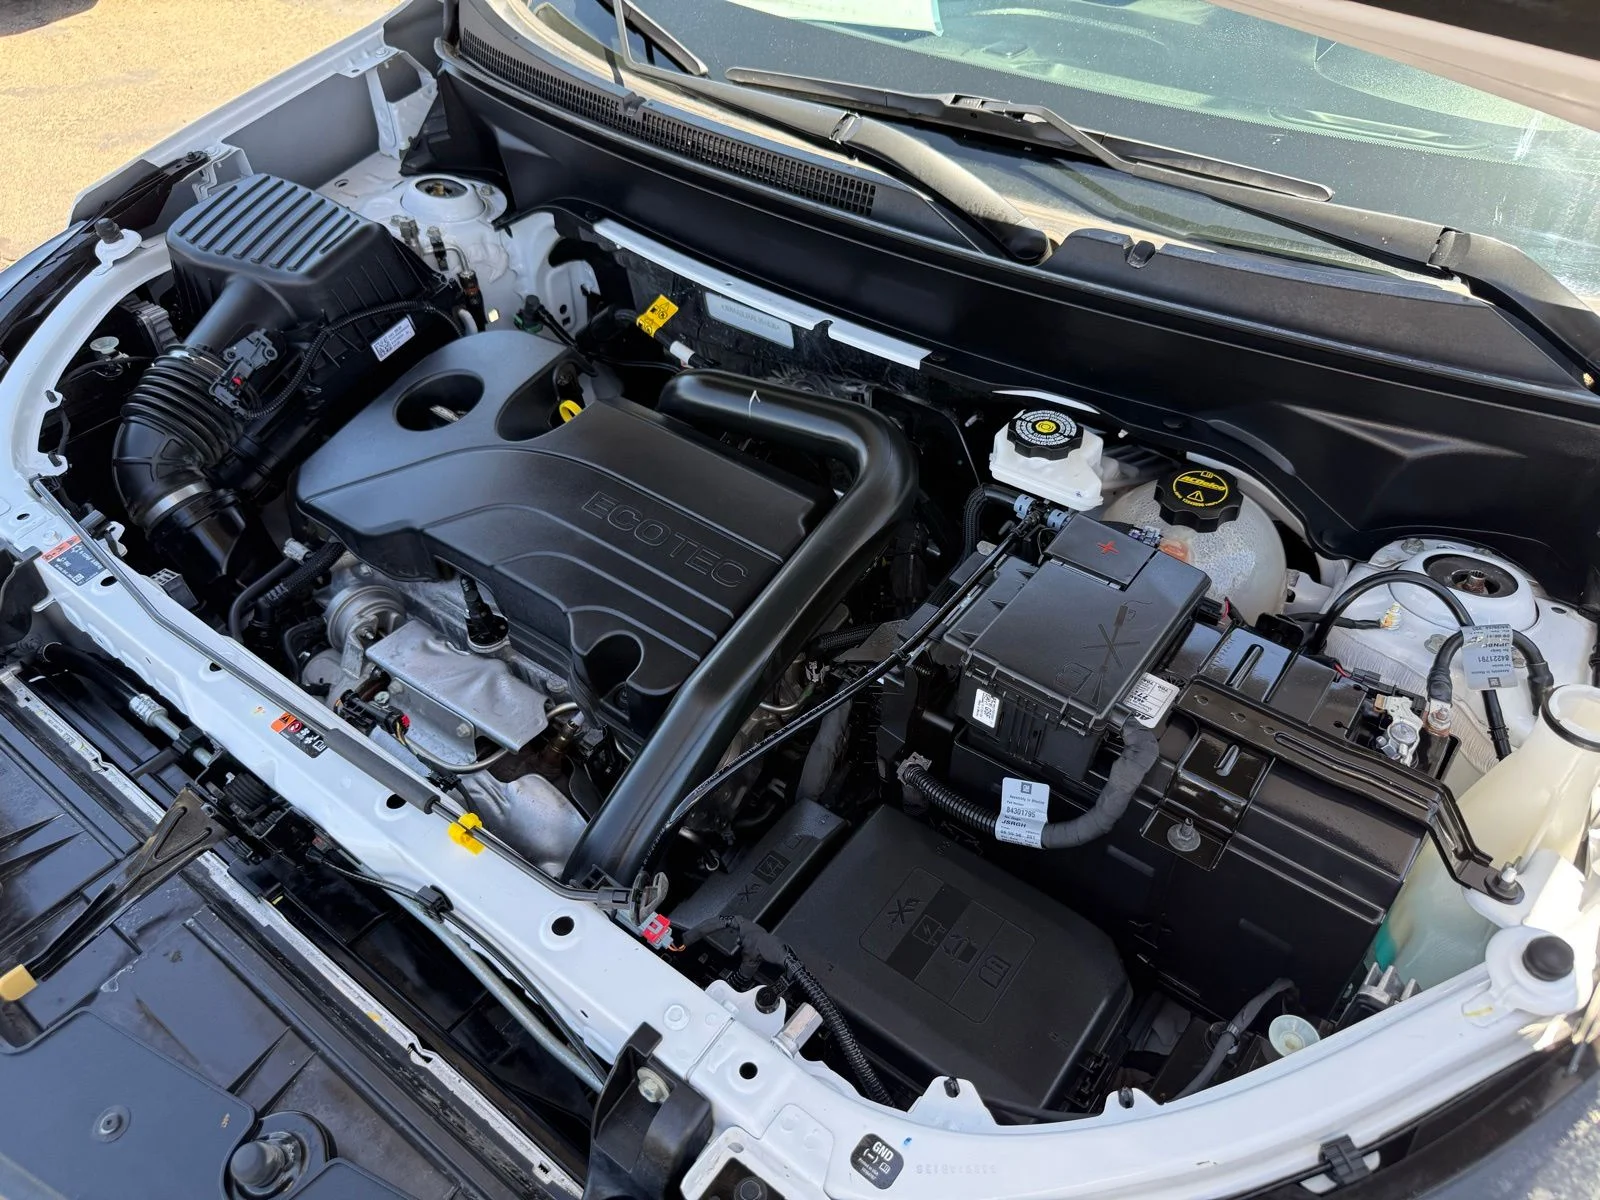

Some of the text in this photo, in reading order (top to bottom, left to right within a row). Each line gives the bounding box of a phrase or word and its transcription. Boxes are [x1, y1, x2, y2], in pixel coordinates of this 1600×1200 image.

[581, 491, 749, 588] ECOTEC
[1006, 806, 1036, 818] 84301795
[872, 1141, 894, 1162] GND
